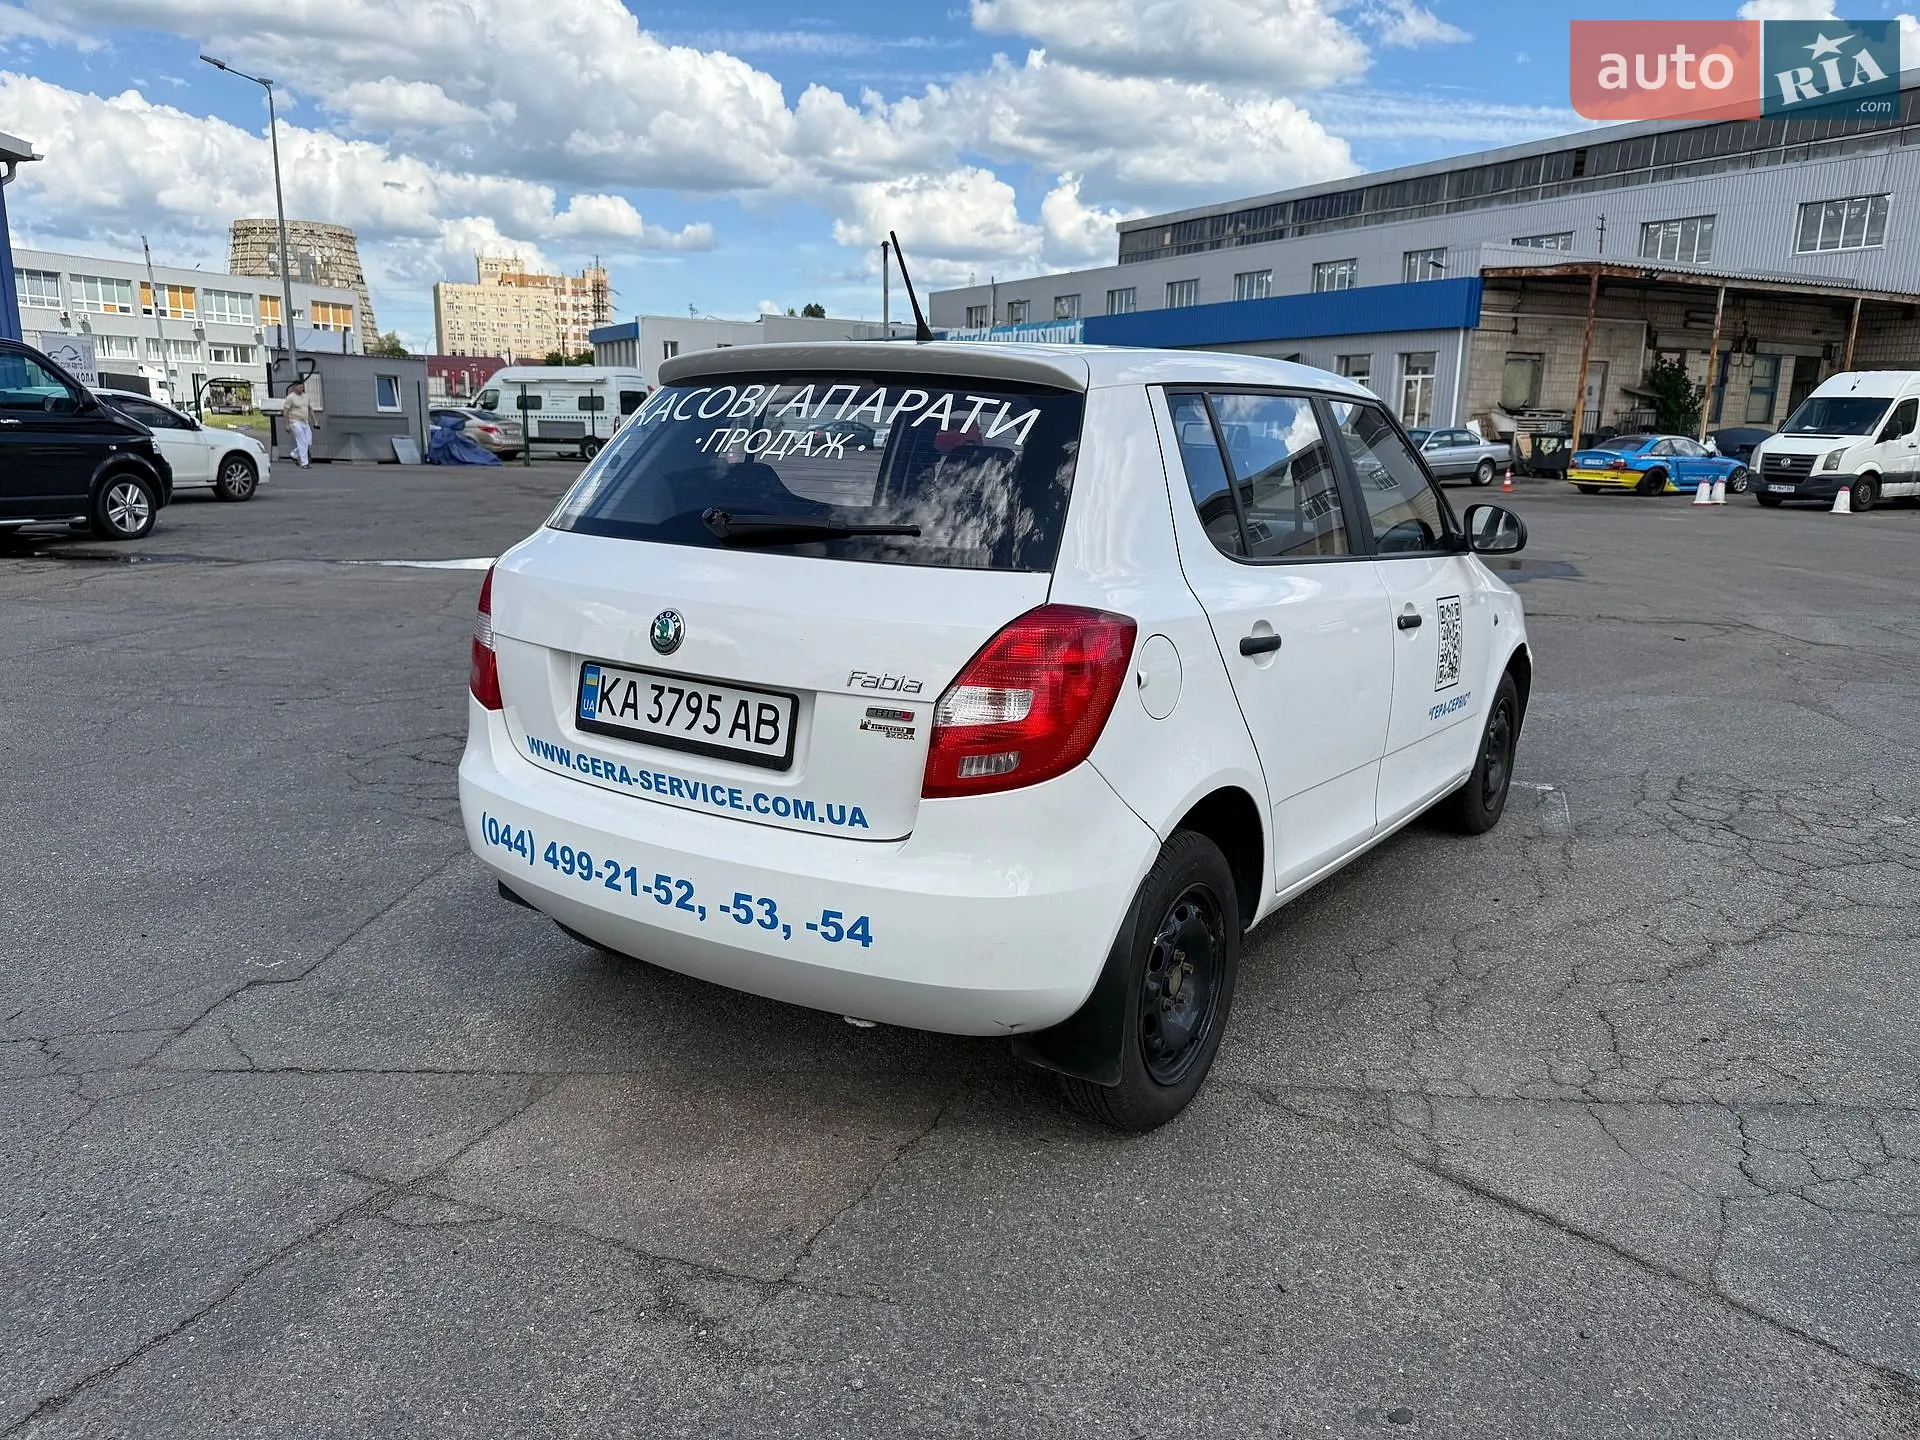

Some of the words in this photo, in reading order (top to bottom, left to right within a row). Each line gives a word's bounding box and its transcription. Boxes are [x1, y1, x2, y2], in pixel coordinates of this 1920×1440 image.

[775, 384, 1042, 446] АПАРАТИ
[583, 699, 596, 712] UA
[598, 675, 639, 721] KA
[646, 684, 723, 735] 3795
[728, 700, 780, 746] AB
[847, 669, 923, 693] Fabia
[527, 735, 869, 829] WWW.GERA-SERVICE.COM.UA
[482, 811, 535, 866] (044)
[544, 841, 707, 922] 499-21-52,
[720, 892, 792, 941] -53,
[806, 909, 873, 948] -54
